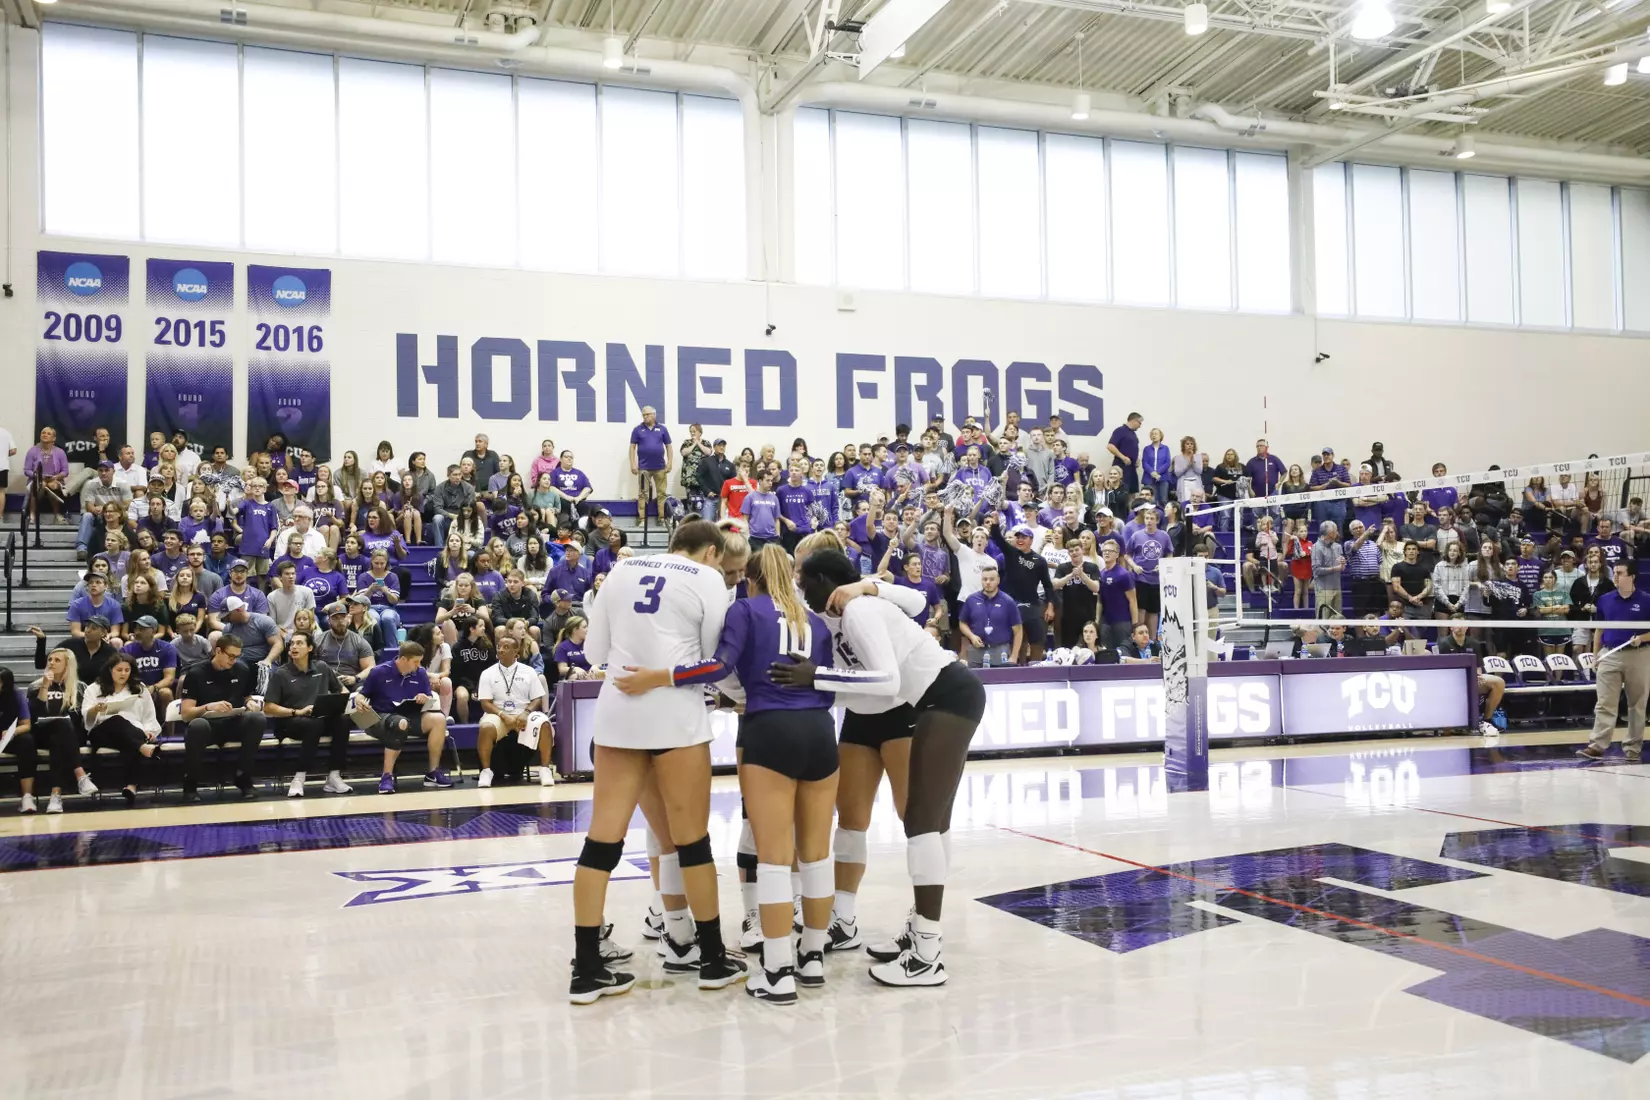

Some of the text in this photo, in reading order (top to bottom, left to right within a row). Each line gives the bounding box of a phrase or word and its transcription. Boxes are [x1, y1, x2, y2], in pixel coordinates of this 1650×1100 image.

[68, 277, 102, 288] NCAA
[176, 283, 207, 294] NCAA
[275, 290, 306, 300] NCAA
[43, 311, 122, 343] 2009
[154, 316, 226, 348] 2015
[255, 322, 324, 353] 2016
[396, 332, 1104, 437] HORNED FROGS
[286, 445, 303, 459] CU
[1335, 489, 1347, 497] TCU
[1373, 485, 1385, 493] TCU
[1412, 480, 1426, 488] TCU
[1456, 475, 1471, 483] TCU
[1503, 469, 1519, 478] TCU
[1553, 463, 1571, 472] TCU
[1608, 456, 1627, 466] TCU
[367, 540, 391, 549] TCU
[623, 559, 662, 569] HORNED
[663, 562, 700, 575] FROGS
[633, 575, 666, 614] 3
[1163, 584, 1178, 598] TCU
[777, 616, 812, 659] 10
[460, 647, 489, 662] TCU
[1551, 656, 1569, 666] TCU
[1583, 655, 1594, 665] TC
[136, 656, 160, 668] TCU
[1488, 657, 1505, 669] TCU
[1520, 657, 1537, 668] TCU
[48, 691, 65, 700] TC
[1341, 672, 1417, 720] TCU
[970, 688, 1080, 746] NED
[1101, 682, 1271, 739] FRGS
[1347, 723, 1413, 732] VOLLEYBALL
